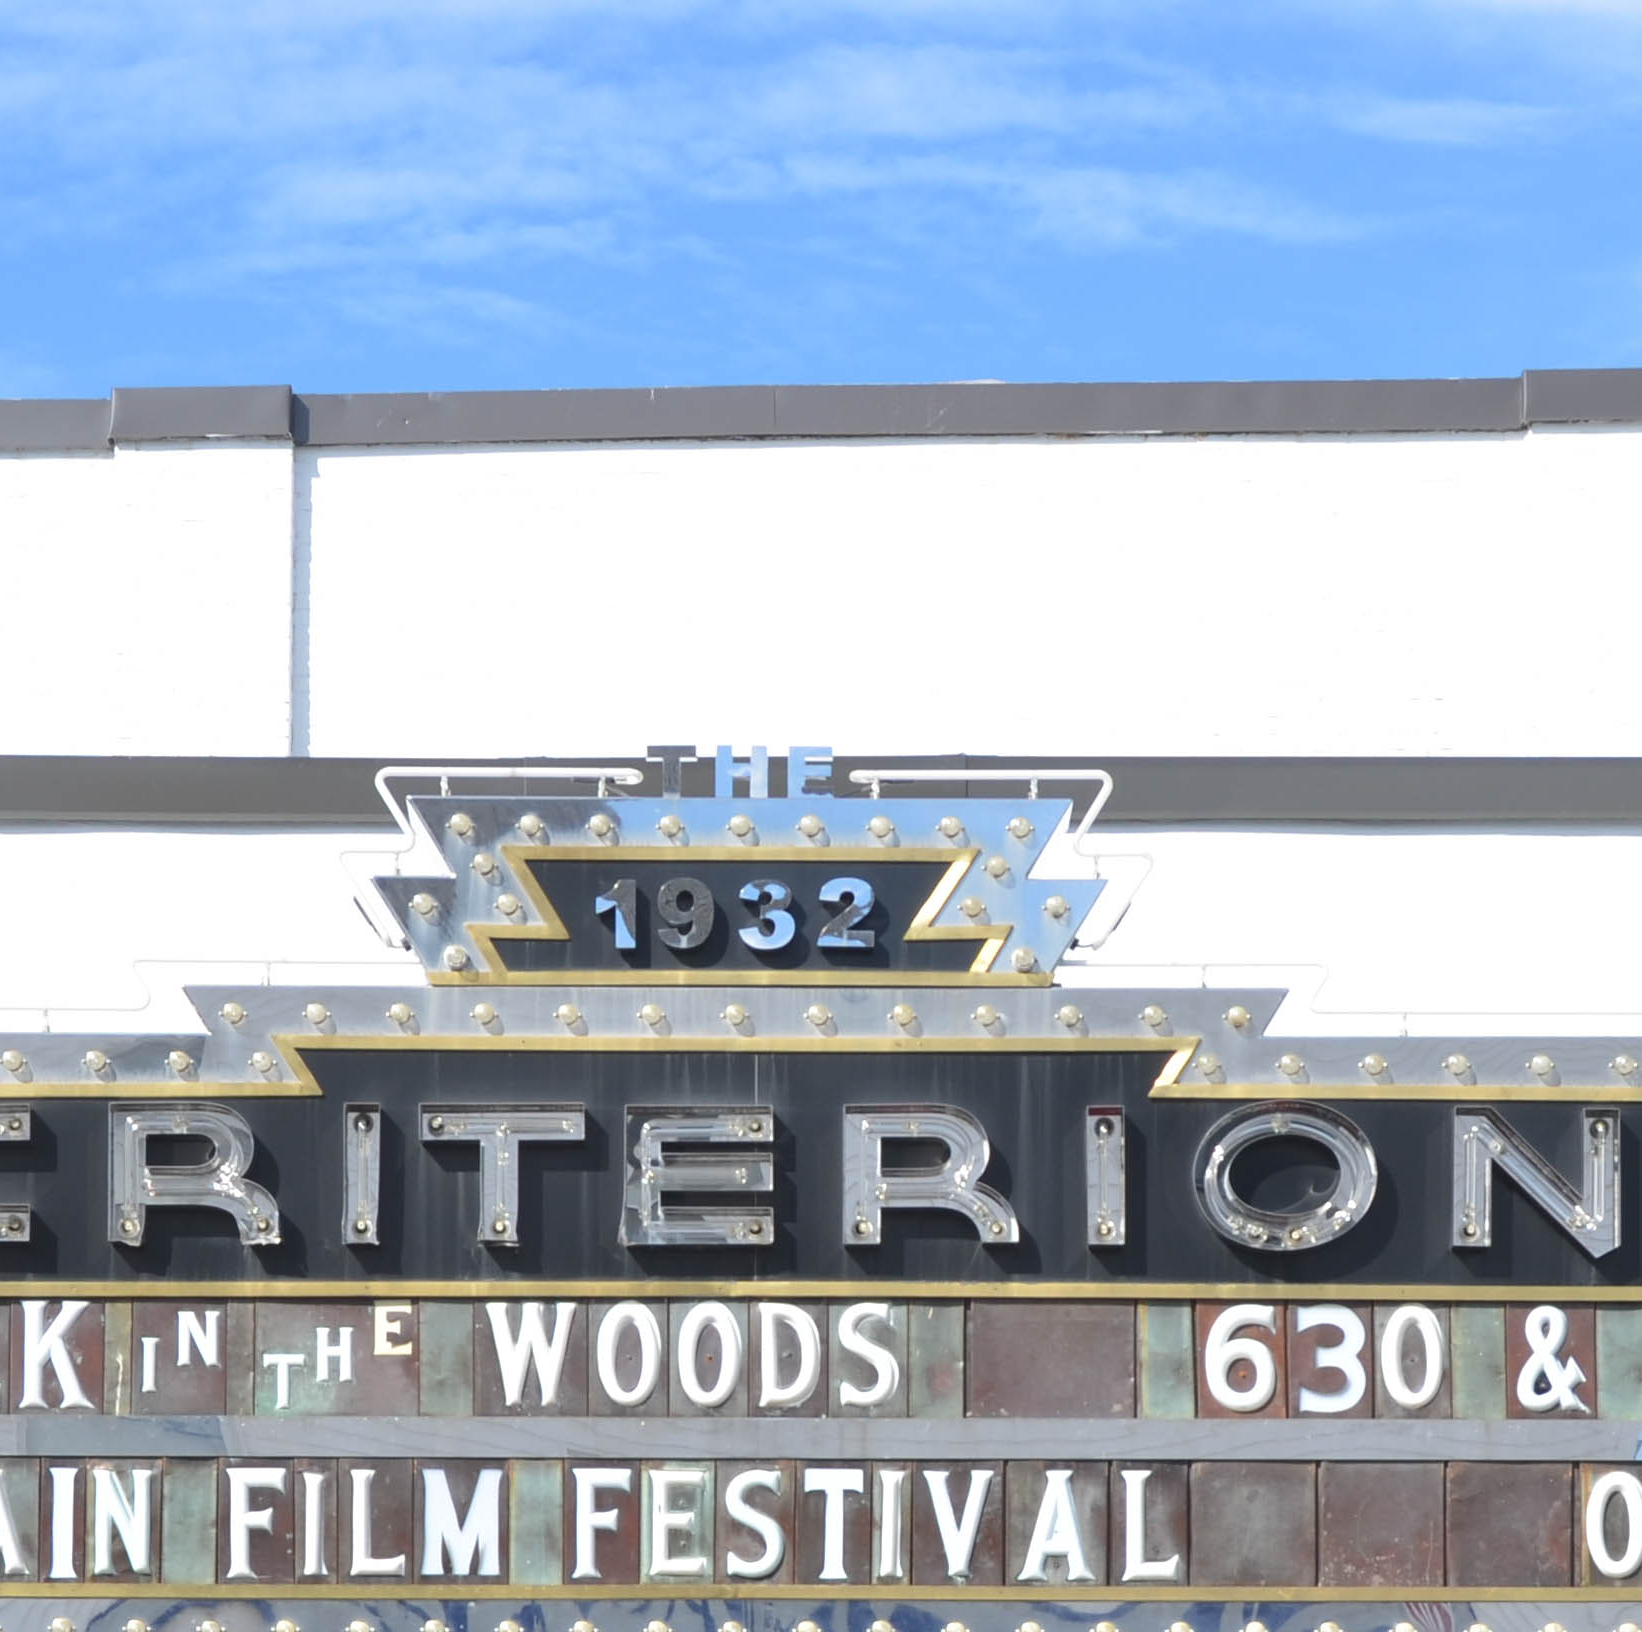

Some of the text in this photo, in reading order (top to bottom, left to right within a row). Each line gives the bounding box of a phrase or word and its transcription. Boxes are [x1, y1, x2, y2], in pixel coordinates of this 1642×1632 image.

[646, 744, 834, 798] THE
[595, 876, 875, 951] 1932
[141, 1311, 221, 1392] IN
[263, 1300, 413, 1411] THE
[487, 1301, 901, 1408] WOODS
[1204, 1303, 1446, 1414] 630
[1516, 1303, 1587, 1413] &
[225, 1467, 503, 1579] FILM
[572, 1467, 1180, 1581] FESTIVAL
